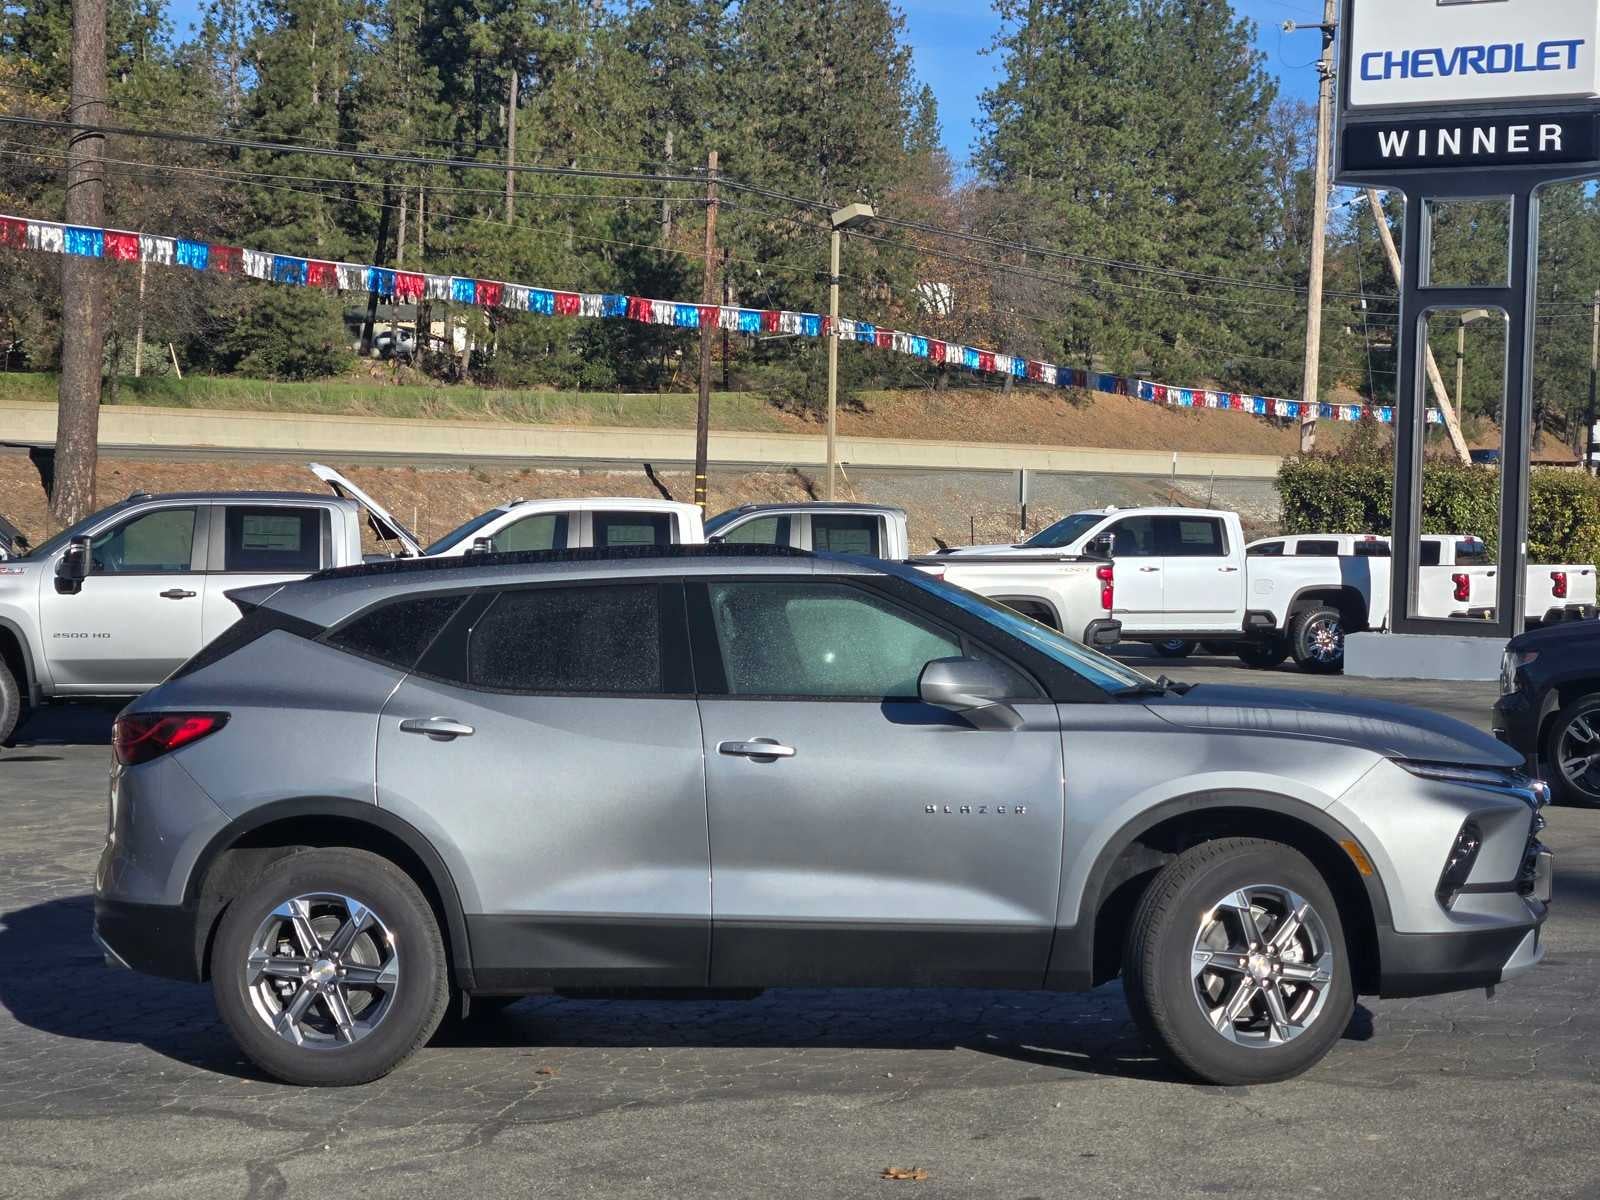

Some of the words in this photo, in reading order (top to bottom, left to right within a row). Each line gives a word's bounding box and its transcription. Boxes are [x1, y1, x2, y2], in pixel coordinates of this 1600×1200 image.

[1360, 39, 1585, 81] CHEVROLET
[1378, 123, 1562, 158] WINNER
[925, 804, 1027, 815] BLAZER
